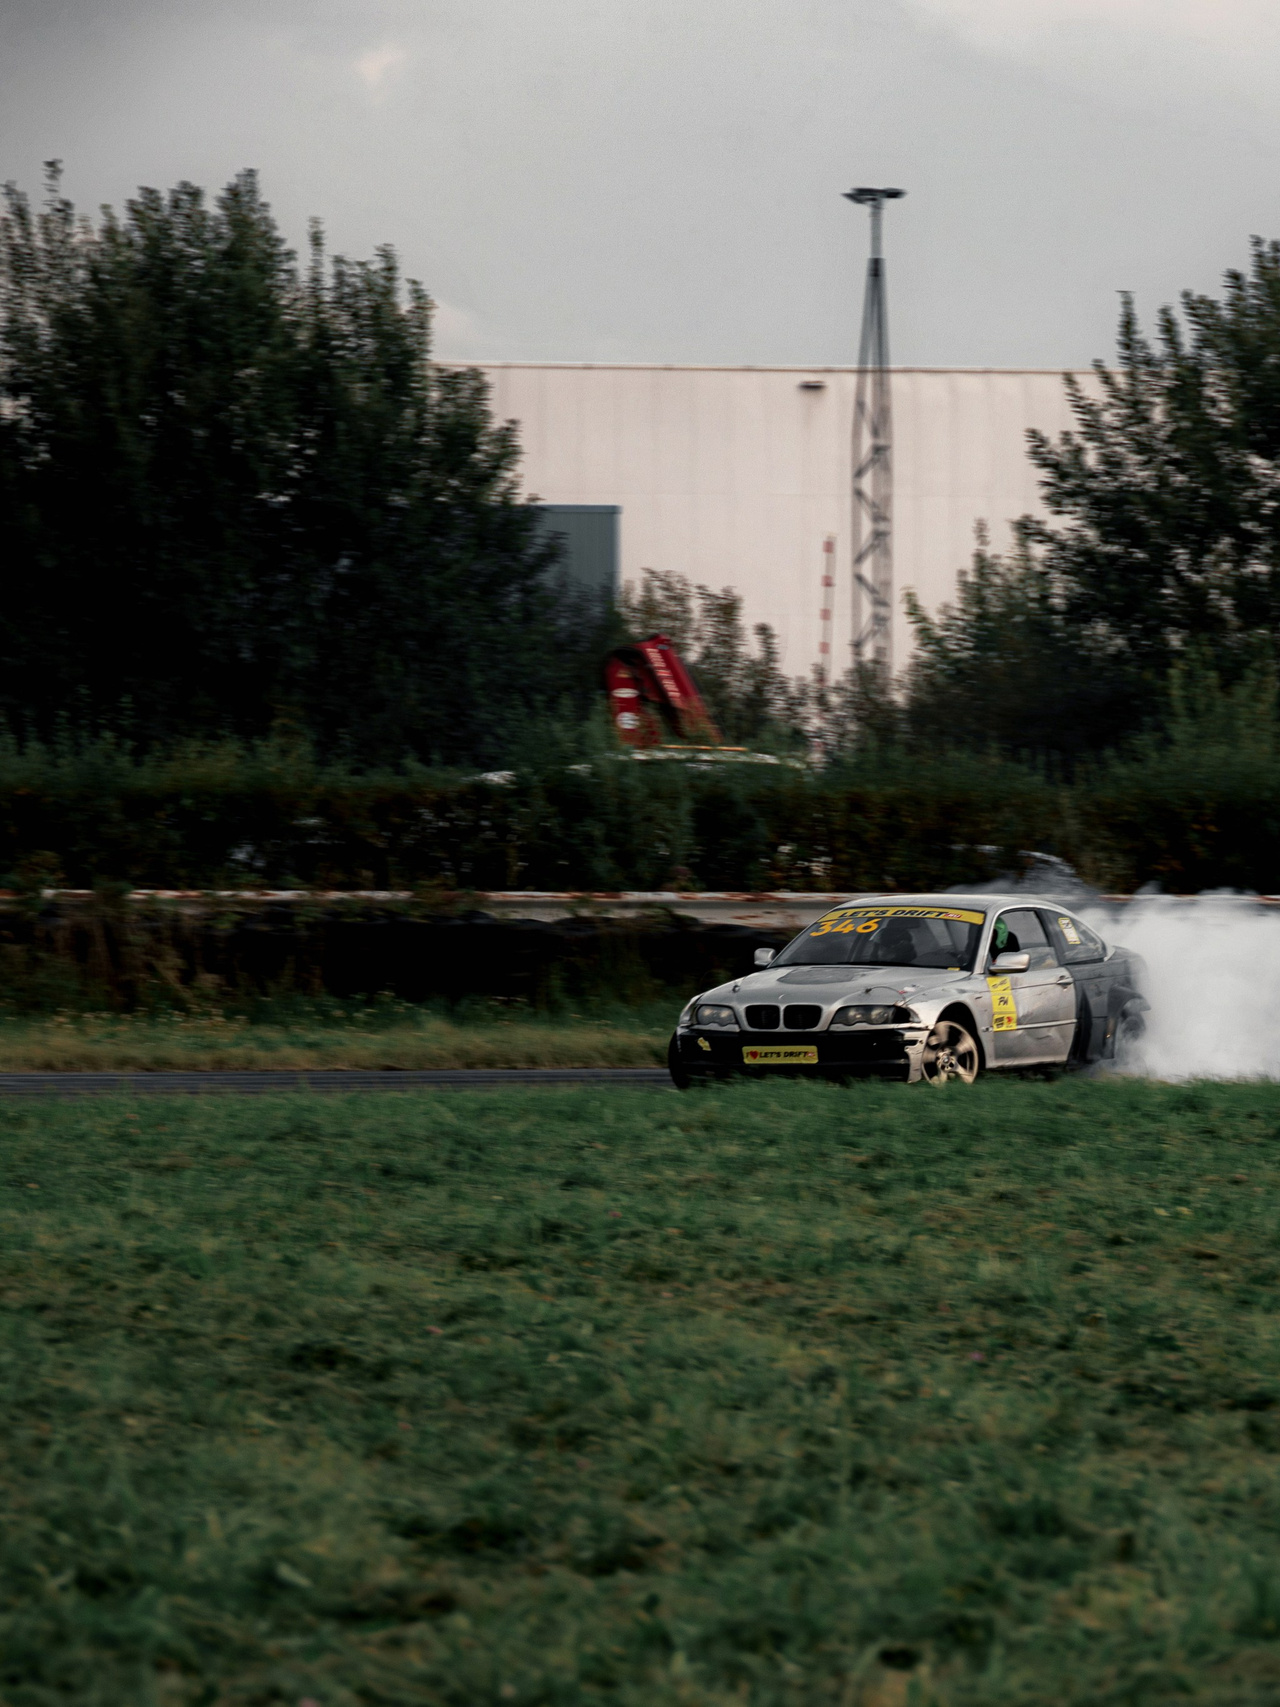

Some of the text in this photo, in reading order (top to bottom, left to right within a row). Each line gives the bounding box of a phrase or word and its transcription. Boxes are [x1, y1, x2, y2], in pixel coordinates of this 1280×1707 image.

[839, 910, 889, 918] LET'S
[892, 909, 948, 917] DRIFT
[809, 918, 882, 937] 346
